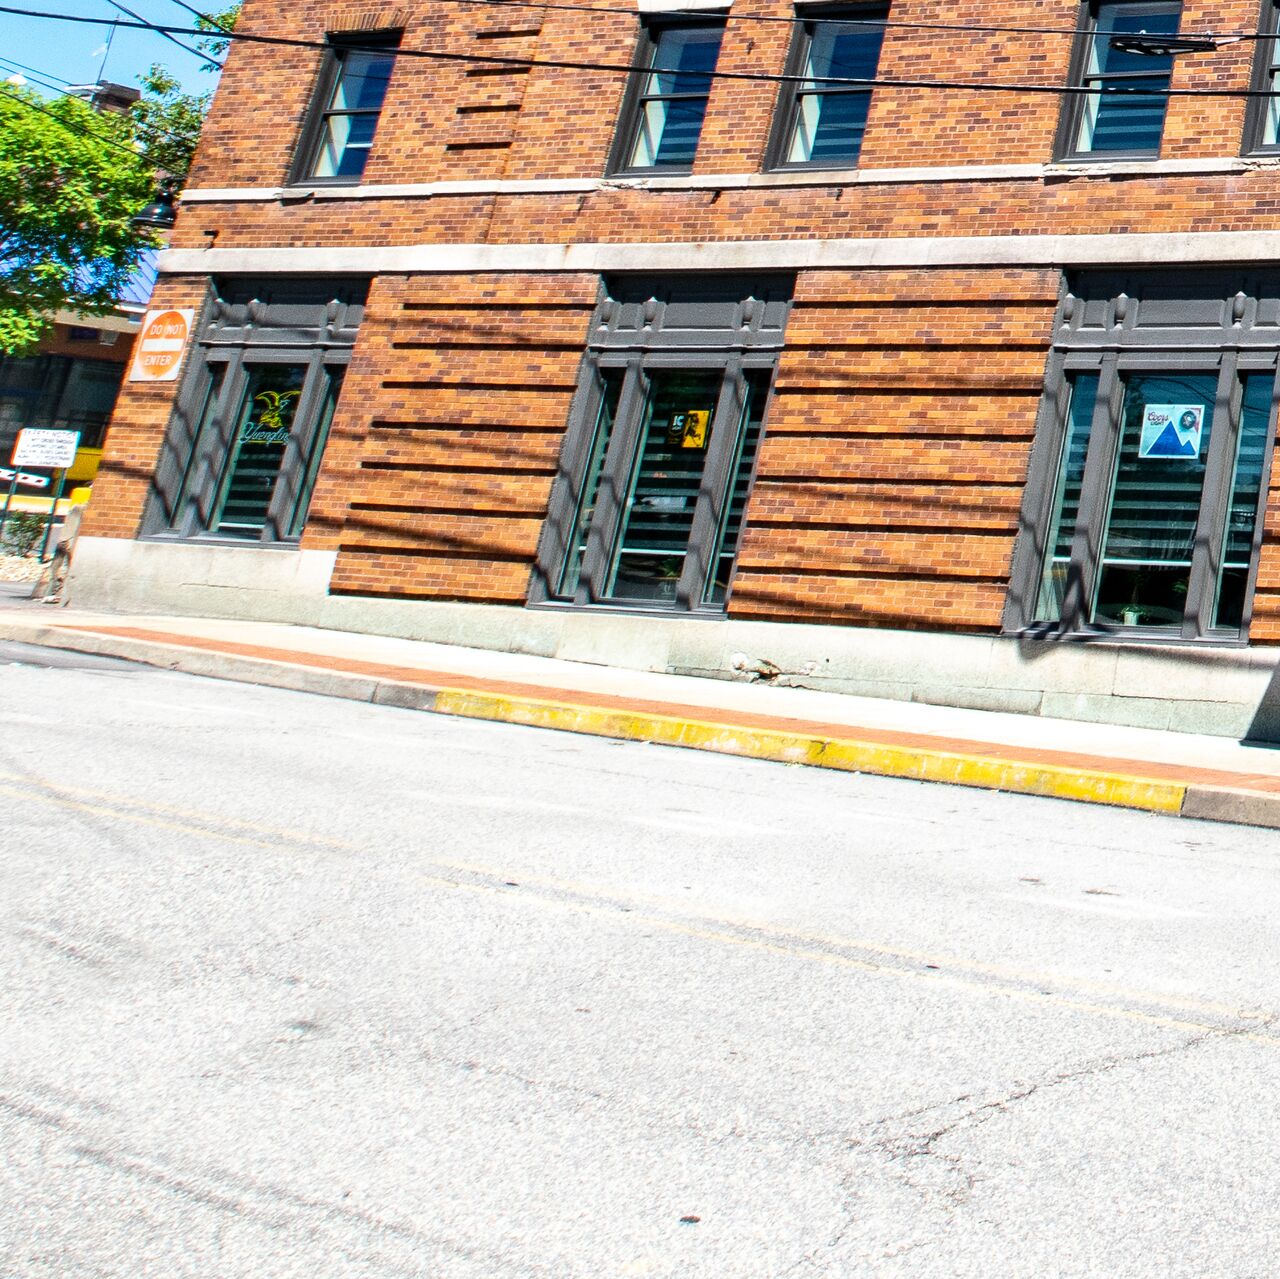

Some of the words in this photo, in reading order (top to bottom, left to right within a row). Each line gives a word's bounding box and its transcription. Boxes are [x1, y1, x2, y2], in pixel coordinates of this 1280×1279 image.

[150, 324, 163, 335] DO
[166, 324, 184, 335] NOT
[144, 355, 172, 366] ENTER
[1147, 411, 1169, 421] Coors
